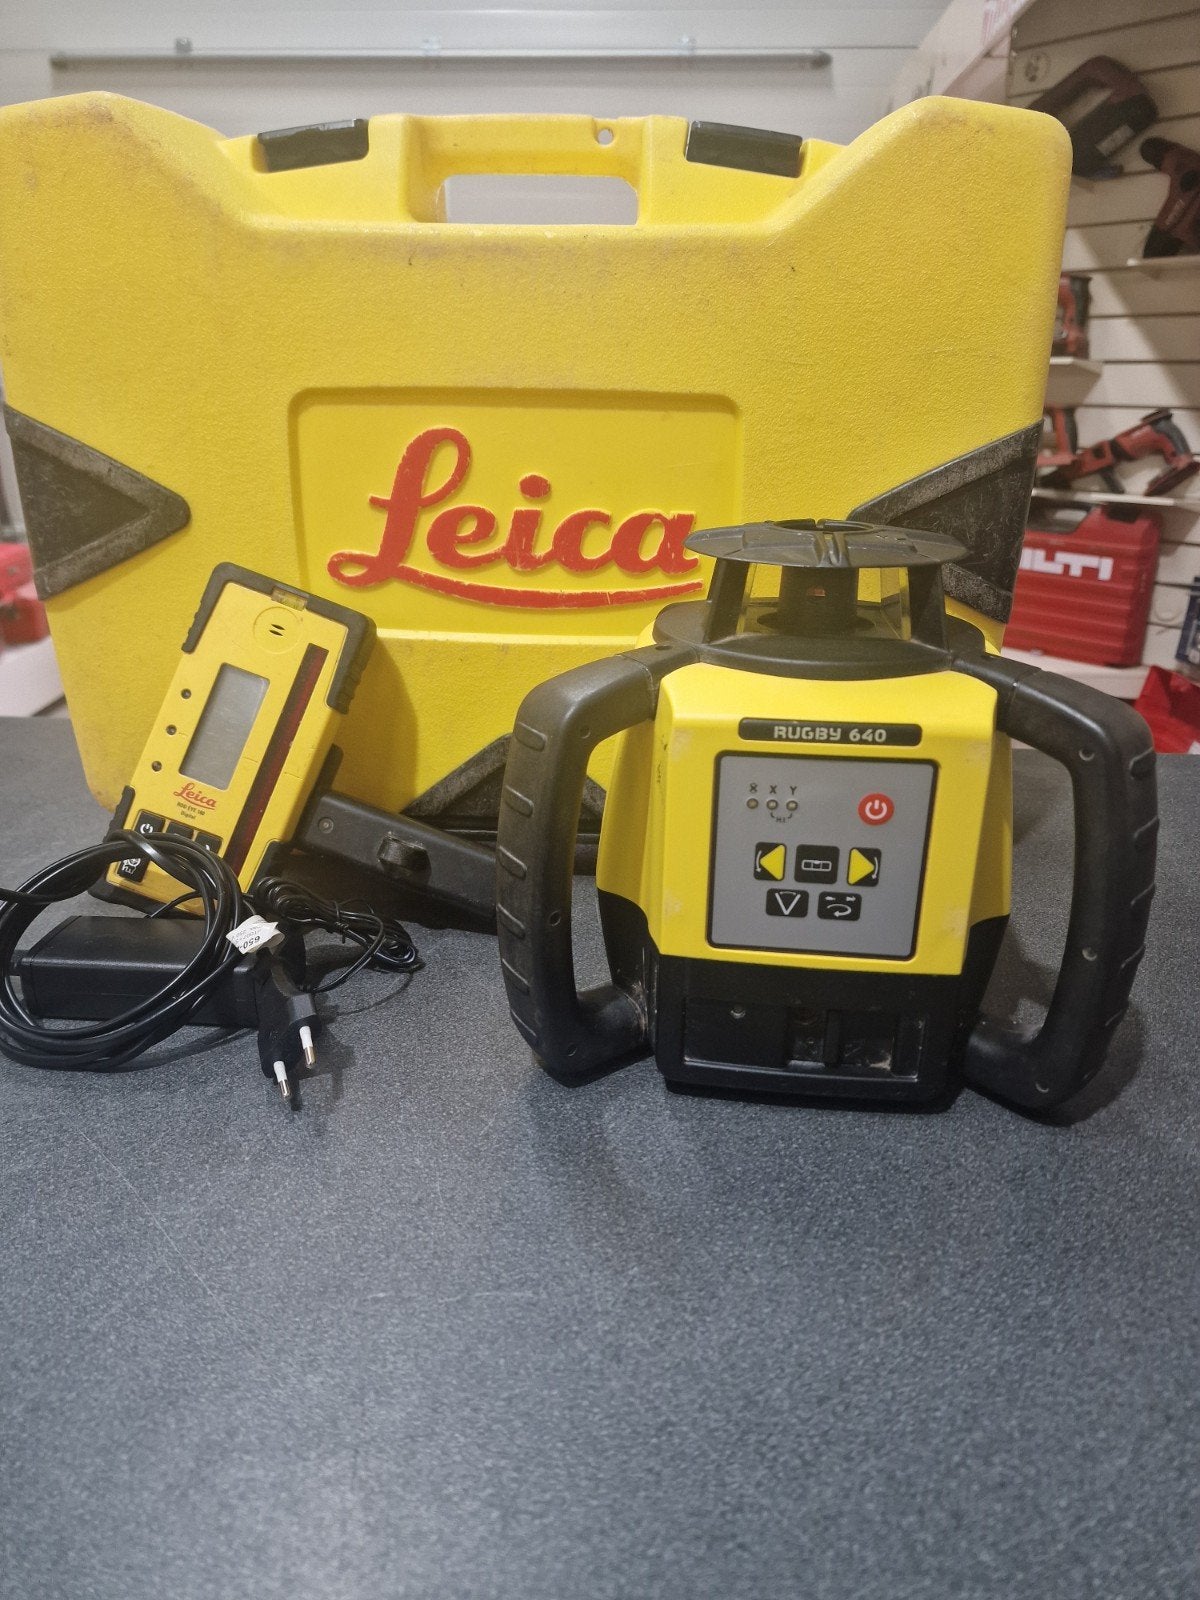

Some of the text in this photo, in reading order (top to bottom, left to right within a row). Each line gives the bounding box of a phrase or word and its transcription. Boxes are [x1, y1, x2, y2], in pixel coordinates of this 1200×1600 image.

[327, 426, 704, 609] Leica
[1019, 547, 1114, 582] ILTI
[774, 725, 887, 743] RUGBY 640
[173, 782, 217, 810] Leica
[769, 784, 778, 795] X
[789, 785, 798, 796] Y
